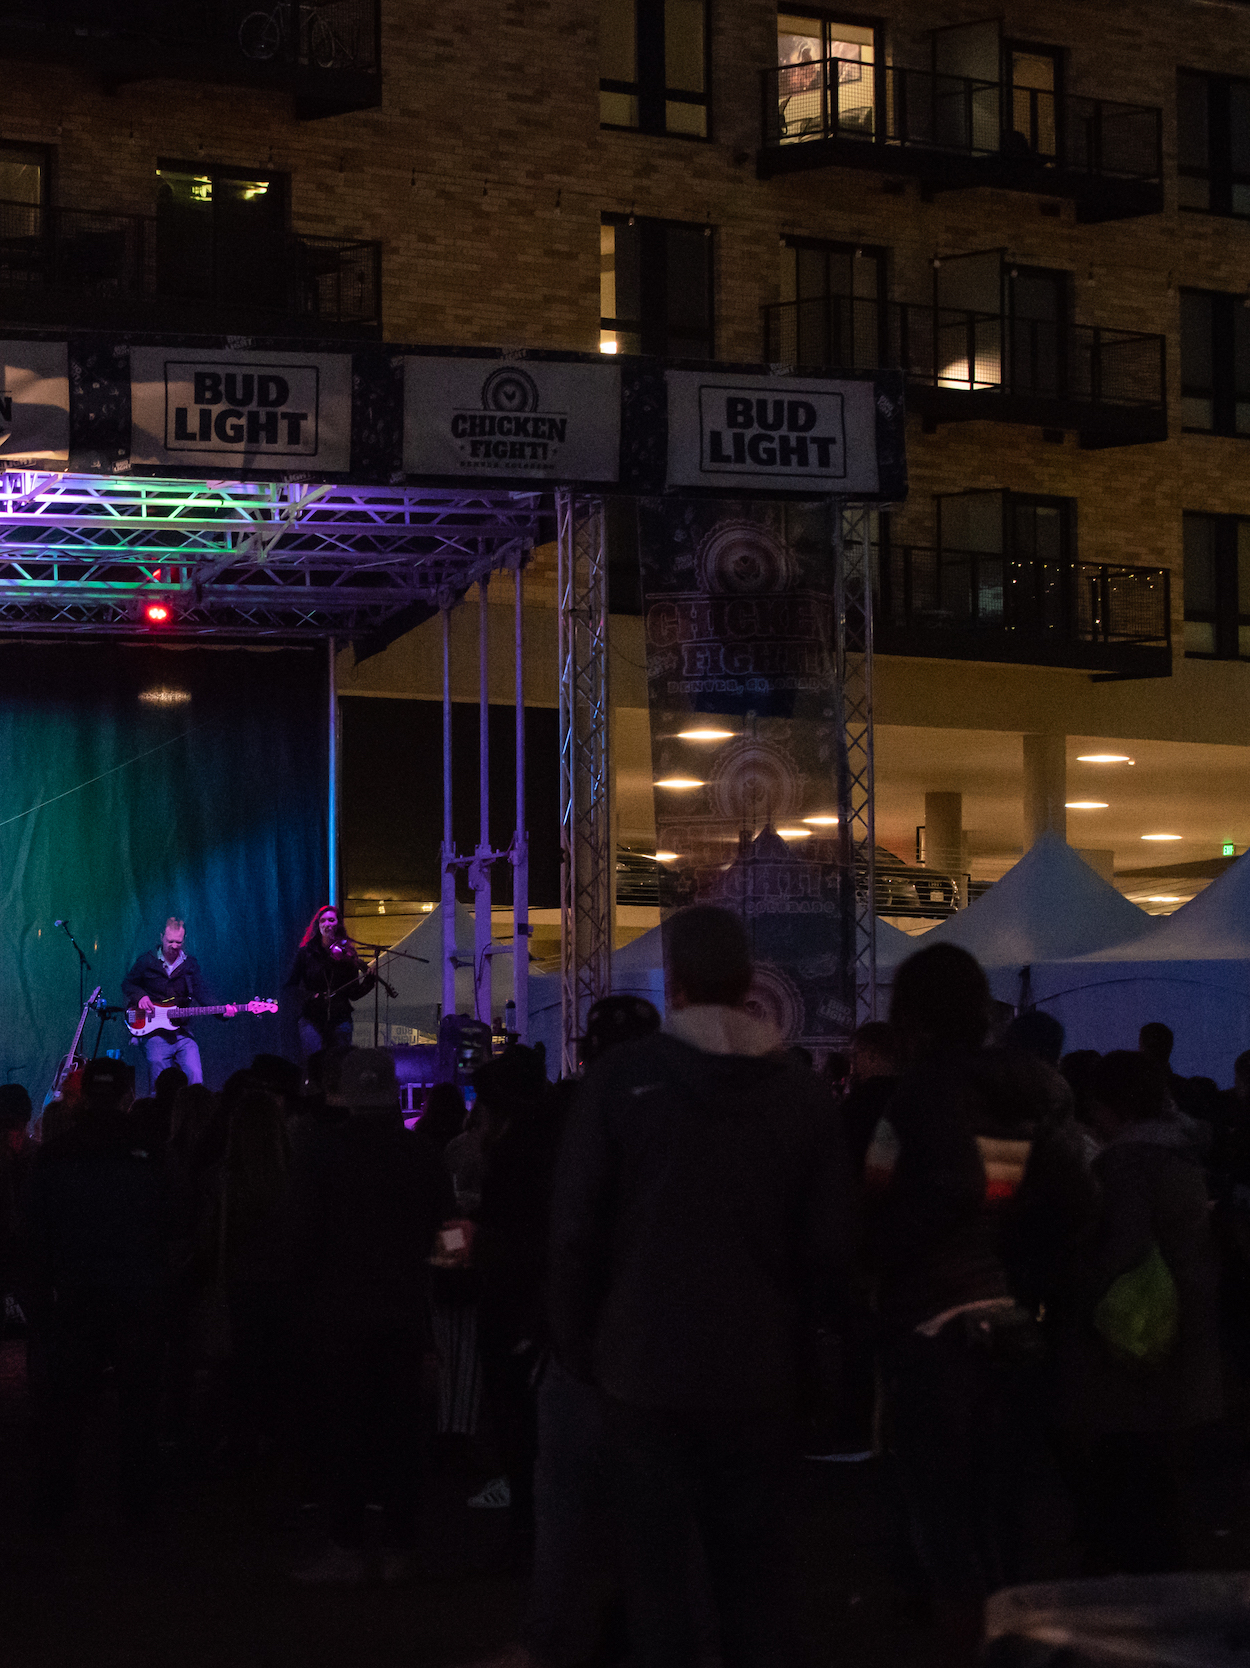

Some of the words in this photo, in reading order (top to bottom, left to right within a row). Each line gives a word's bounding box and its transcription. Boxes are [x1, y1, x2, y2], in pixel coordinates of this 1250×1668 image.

[194, 371, 290, 408] BUD
[174, 407, 309, 446] LIGHT
[451, 413, 568, 443] CHICKEN
[726, 396, 817, 433] BUD
[470, 439, 549, 461] FIGHT!
[709, 430, 837, 469] LIGHT
